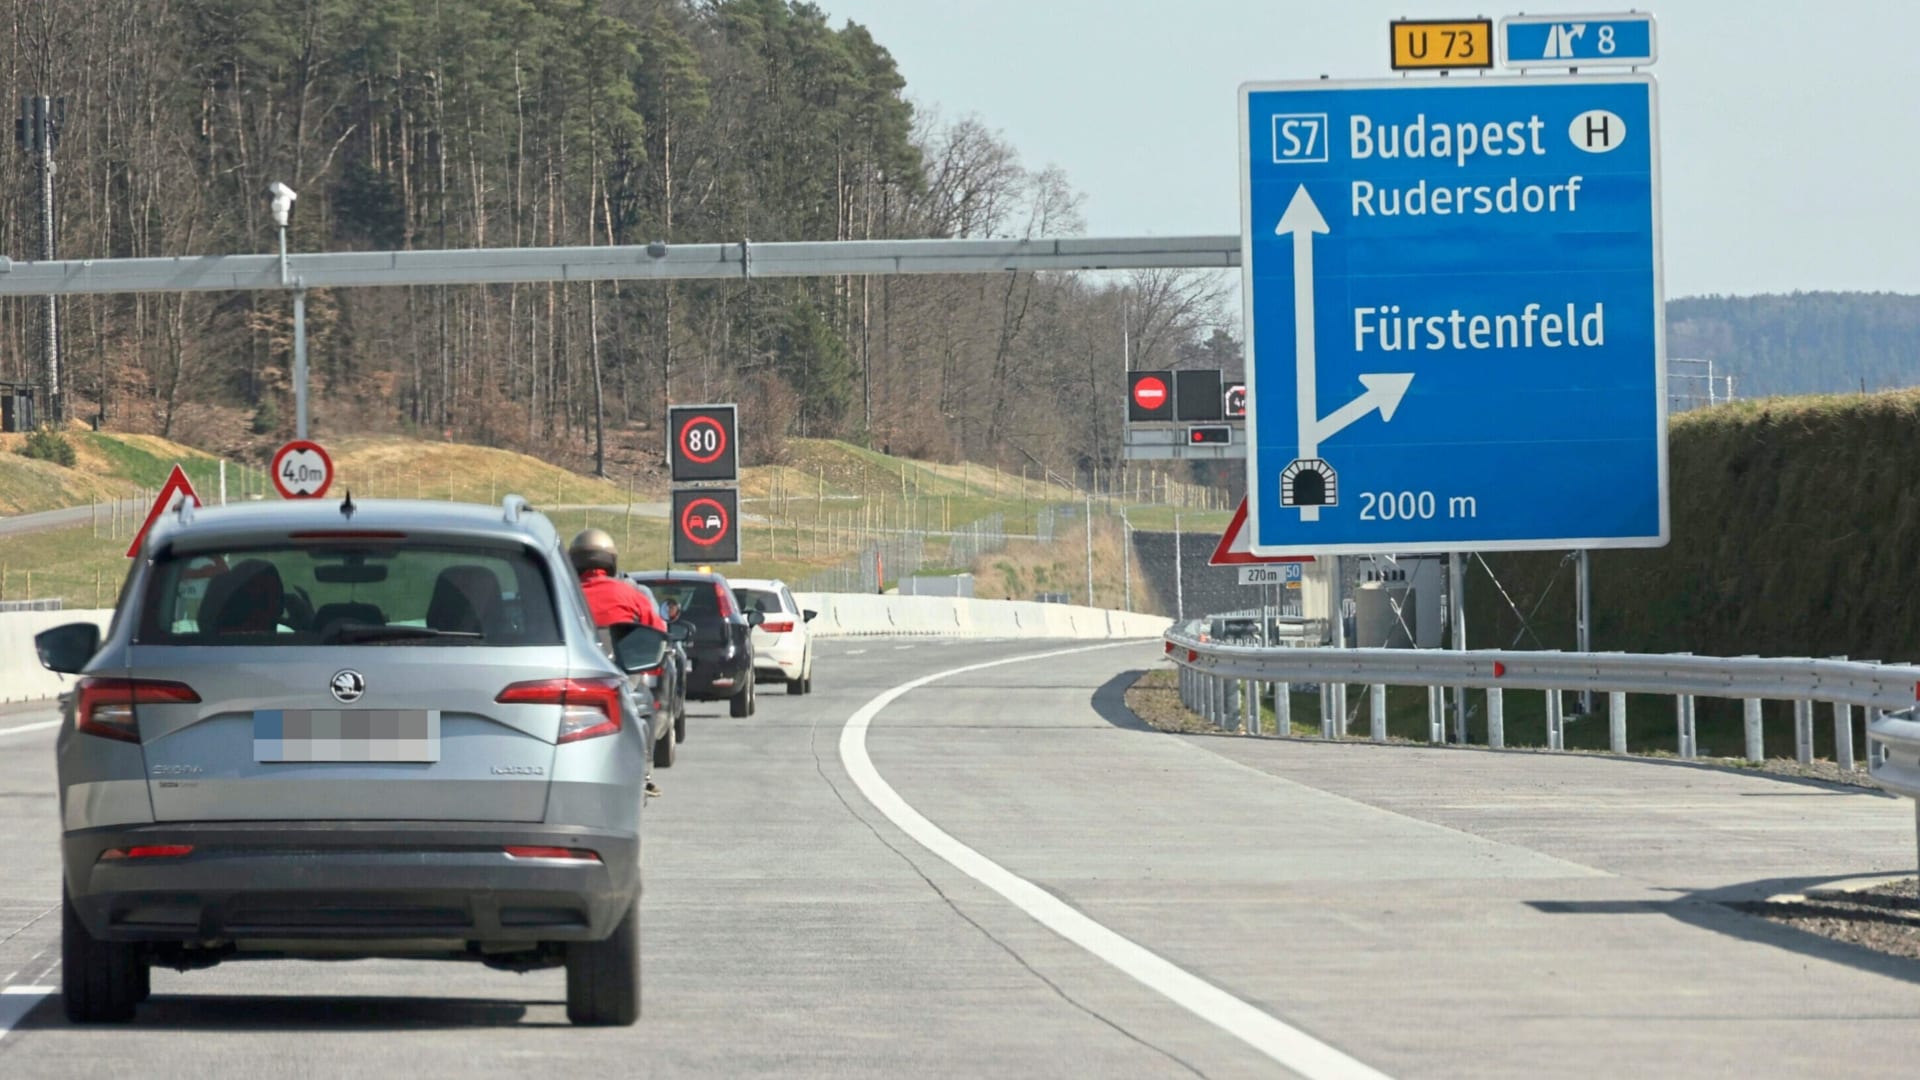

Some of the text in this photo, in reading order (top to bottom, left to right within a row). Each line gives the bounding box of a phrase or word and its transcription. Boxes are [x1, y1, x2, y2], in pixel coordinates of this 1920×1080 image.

[1408, 31, 1475, 59] U 73
[1597, 25, 1617, 55] 8
[1281, 120, 1320, 157] S7
[1349, 113, 1610, 167] Budapest H
[1351, 176, 1583, 216] Rudersdorf
[1354, 302, 1605, 352] Fürstenfeld
[689, 429, 717, 452] 80
[1358, 491, 1477, 521] 2000 m
